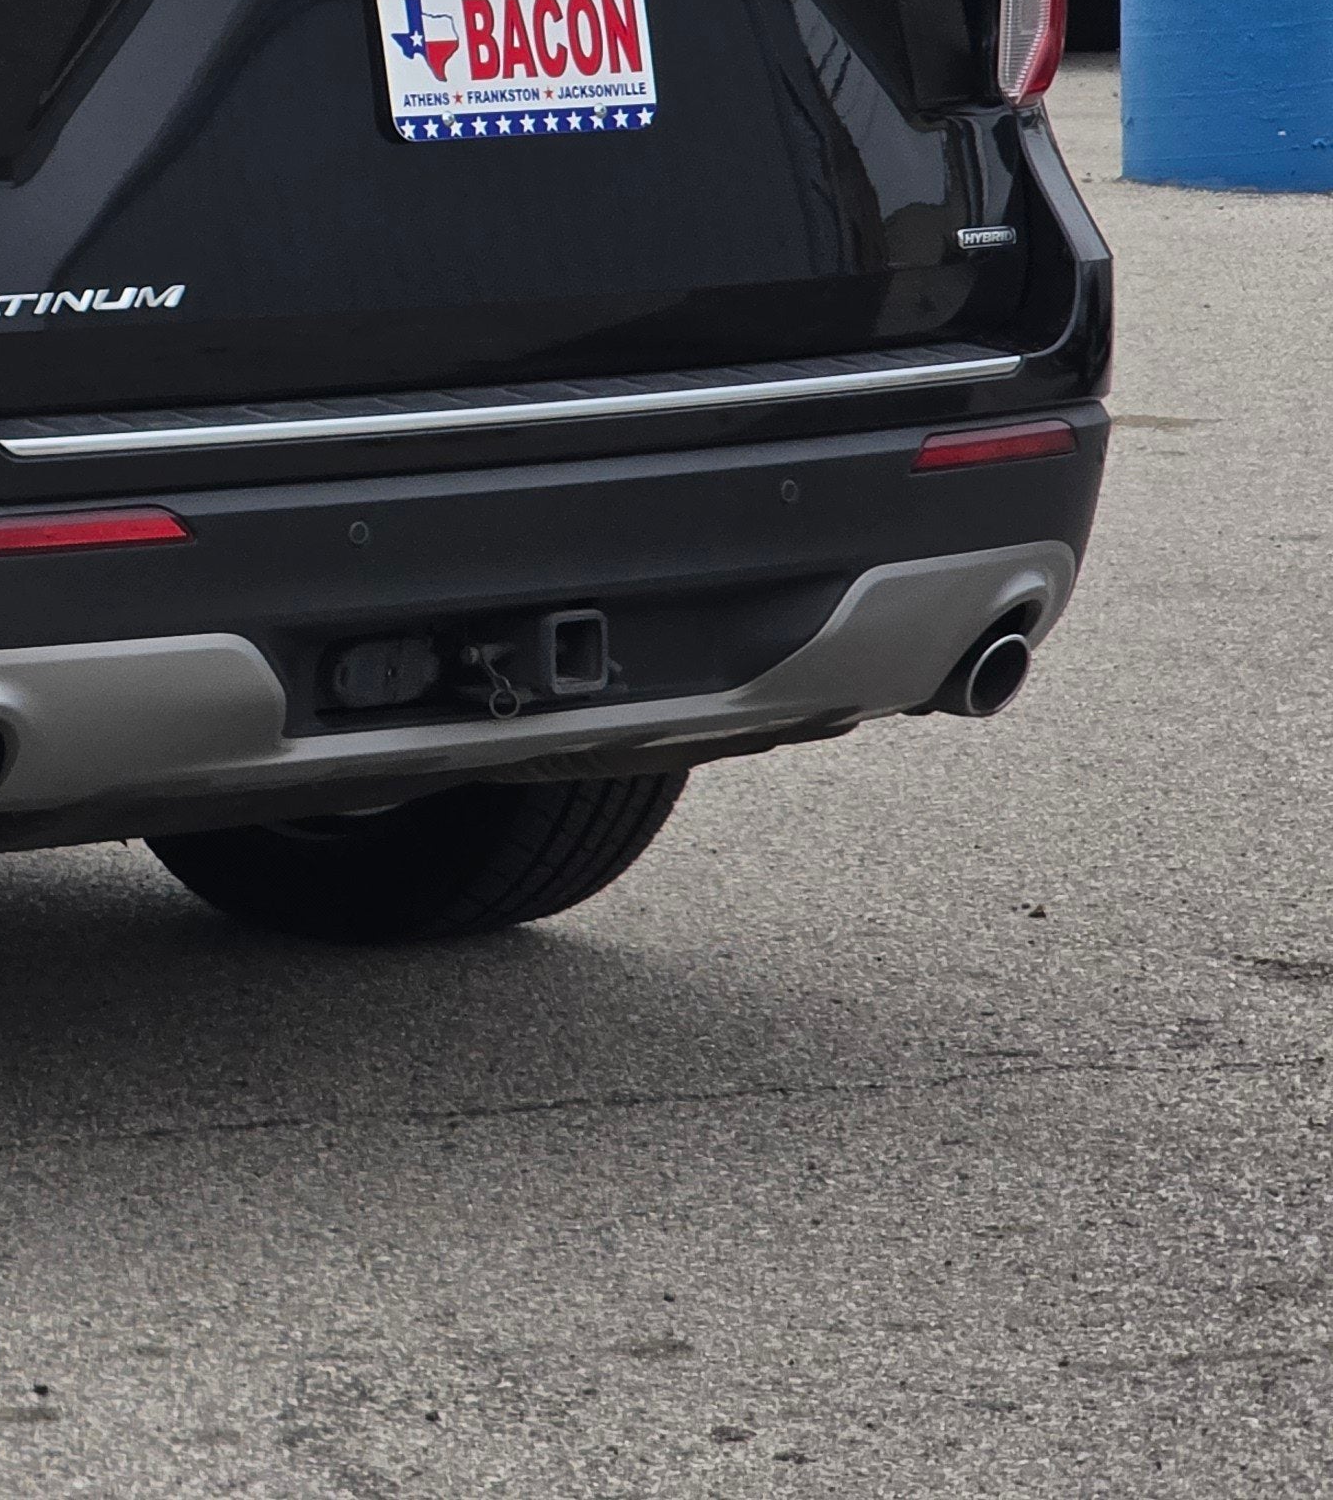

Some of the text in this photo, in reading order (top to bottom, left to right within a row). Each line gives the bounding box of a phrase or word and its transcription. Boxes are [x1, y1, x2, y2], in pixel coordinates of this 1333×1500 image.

[403, 81, 647, 108] ATHENS FRANKSTON JACKSONVILLE
[964, 230, 1013, 244] HYBRID
